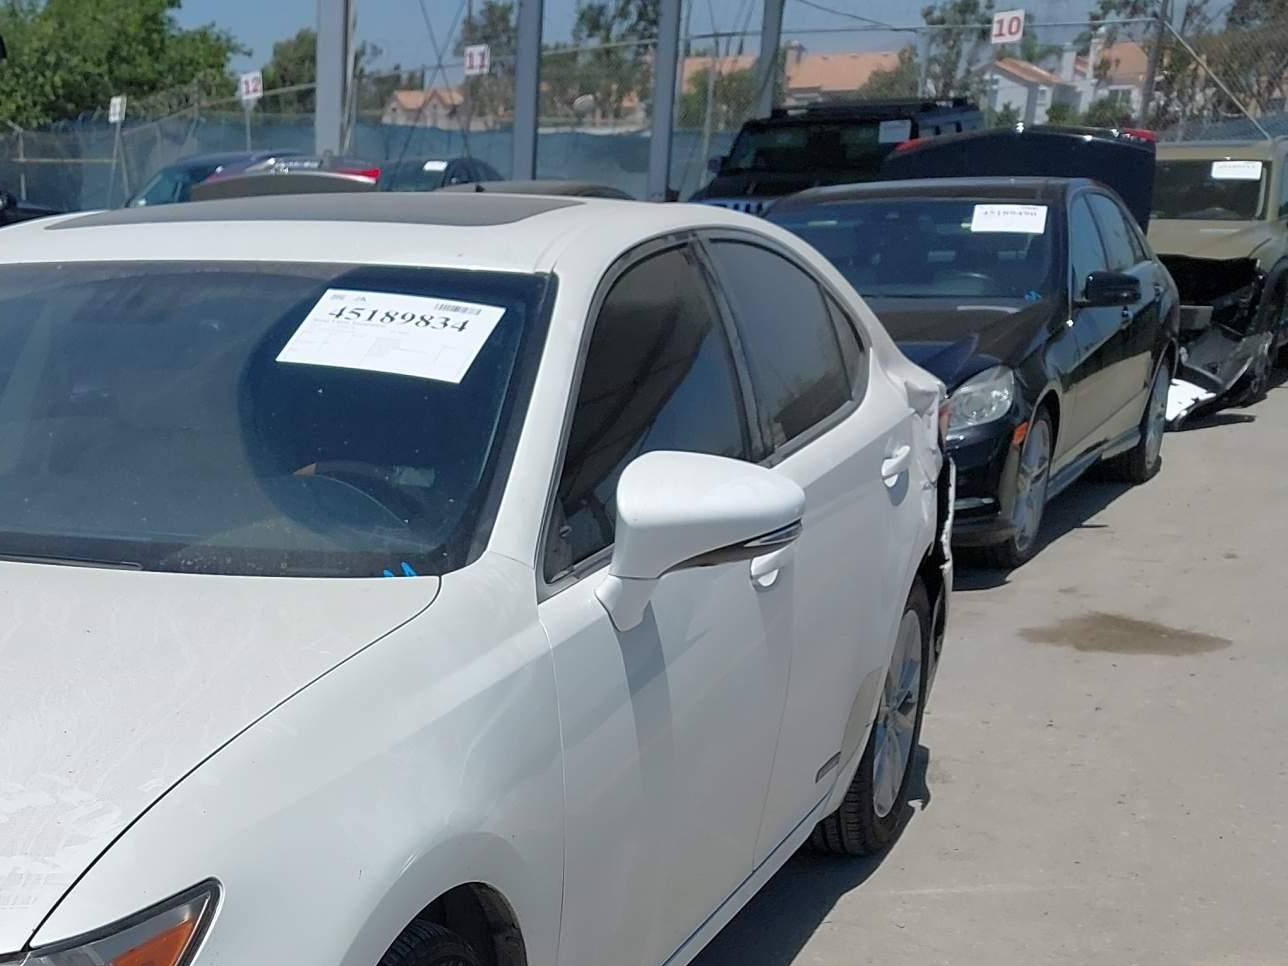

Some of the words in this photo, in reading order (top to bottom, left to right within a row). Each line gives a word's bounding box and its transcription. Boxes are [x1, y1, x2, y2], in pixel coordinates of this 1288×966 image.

[993, 15, 1022, 38] 10
[467, 51, 487, 70] 11
[243, 76, 261, 96] 12
[328, 305, 470, 333] 45189834
